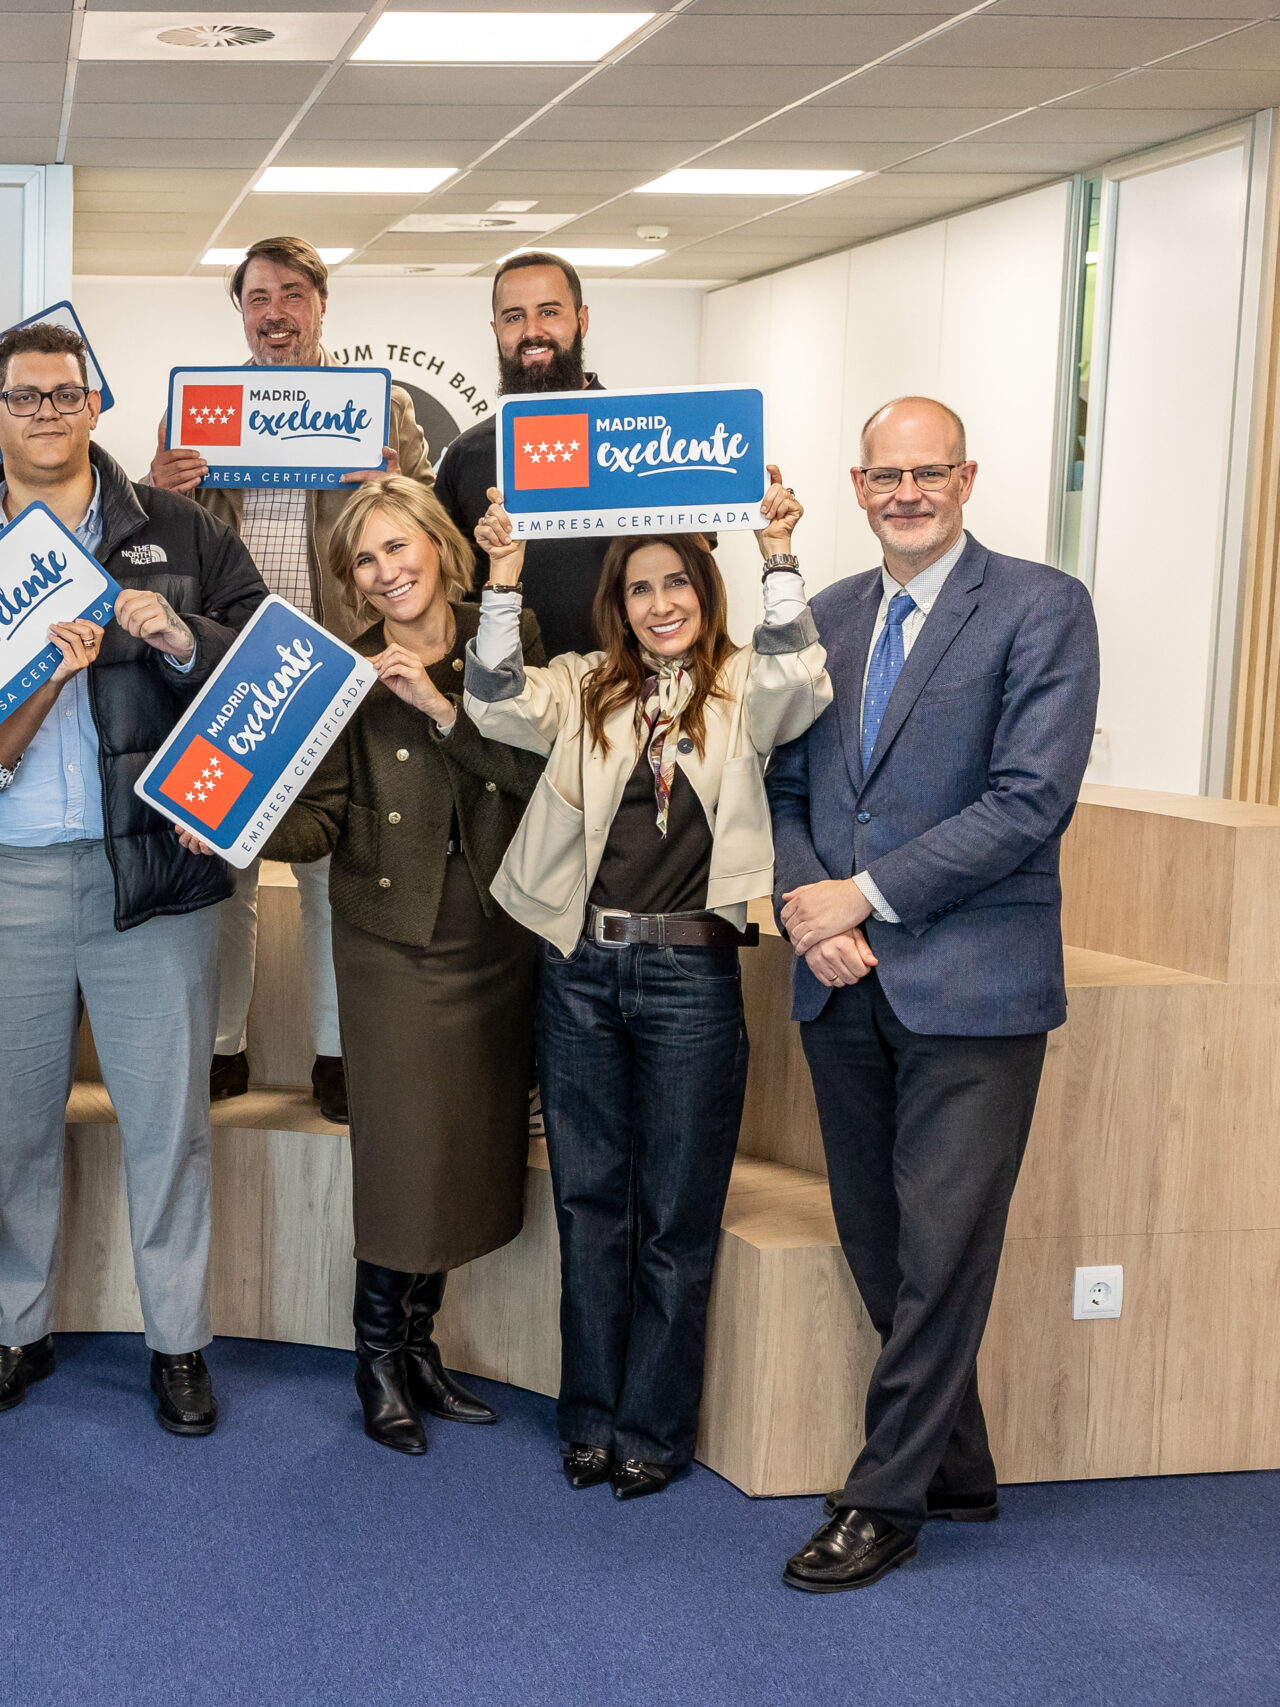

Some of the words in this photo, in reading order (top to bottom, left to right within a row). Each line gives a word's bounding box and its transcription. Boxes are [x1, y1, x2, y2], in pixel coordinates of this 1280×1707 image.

[249, 390, 307, 402] MADRID
[334, 344, 373, 364] UM
[387, 344, 445, 376] TECH
[449, 372, 489, 416] BAR
[248, 399, 372, 436] excelente
[596, 415, 667, 432] MADRID
[597, 422, 749, 473] excelente
[203, 472, 252, 482] PRESA
[261, 473, 344, 483] CERTIFIC
[518, 517, 605, 532] EMPRESA
[617, 511, 750, 528] CERTIFICADA
[121, 550, 151, 558] NORTH
[21, 602, 112, 688] CERTIDA
[206, 681, 250, 737] MADRID
[228, 638, 314, 755] excelente
[241, 783, 294, 852] EMPRESA
[294, 677, 366, 776] CERTIFICADA
